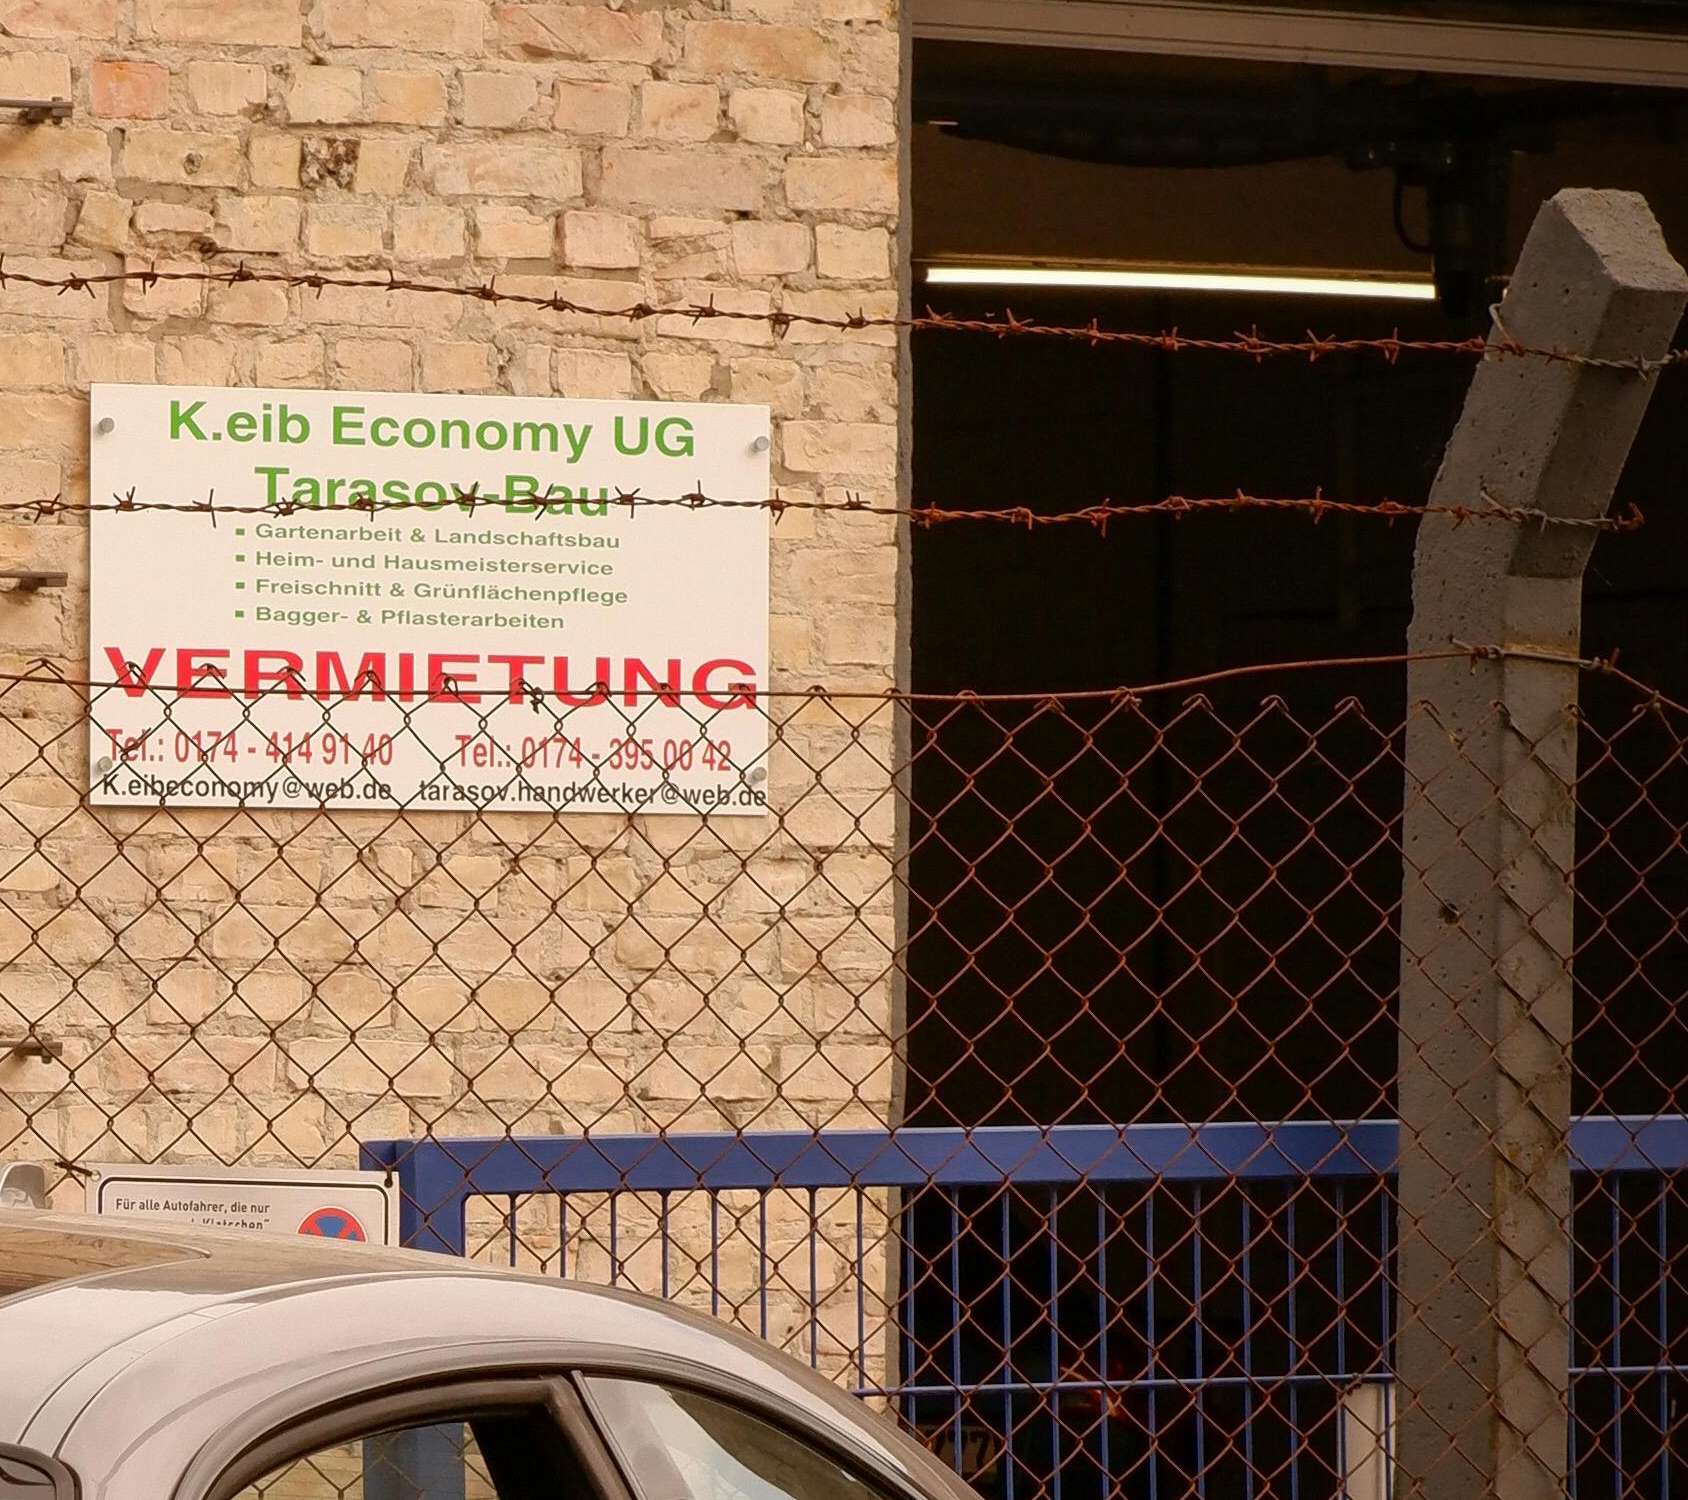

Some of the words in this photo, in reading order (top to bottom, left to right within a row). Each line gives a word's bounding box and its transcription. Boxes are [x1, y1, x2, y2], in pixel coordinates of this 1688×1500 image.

[169, 401, 312, 443] K.eib
[331, 406, 593, 463] Economy
[613, 416, 696, 456] UG
[254, 466, 609, 517] Tarasov-Bau
[255, 523, 401, 542] Gartenarbeit
[411, 527, 426, 543] &
[435, 529, 620, 548] Landschaftsbau
[256, 552, 323, 569] Heim-
[332, 554, 375, 570] und
[384, 555, 613, 576] Hausmeisterservice
[256, 579, 381, 596] Freischnitt
[390, 582, 404, 598] &
[414, 582, 628, 607] Grünflächenpflege
[256, 607, 348, 627] Bagger-
[357, 610, 371, 625] &
[382, 610, 564, 629] Pflasterarbeiten
[104, 647, 759, 710] VERMIETUNG
[107, 730, 165, 763] Tel.:
[174, 732, 238, 764] 0174
[265, 734, 312, 765] 414
[321, 735, 349, 765] 91
[362, 735, 393, 766] 40
[455, 735, 512, 768] Tel.:
[521, 737, 582, 769] 0174
[609, 739, 657, 771] 395
[664, 740, 693, 772] 00
[702, 740, 731, 772] 42
[102, 773, 392, 803] K.eibeconomy@web.de
[418, 780, 766, 807] tarasov.handwerker@web.de
[116, 1199, 135, 1211] Für
[139, 1199, 160, 1212] alle
[163, 1200, 227, 1213] Autofahrer,
[230, 1201, 248, 1214] die
[251, 1203, 270, 1214] nur
